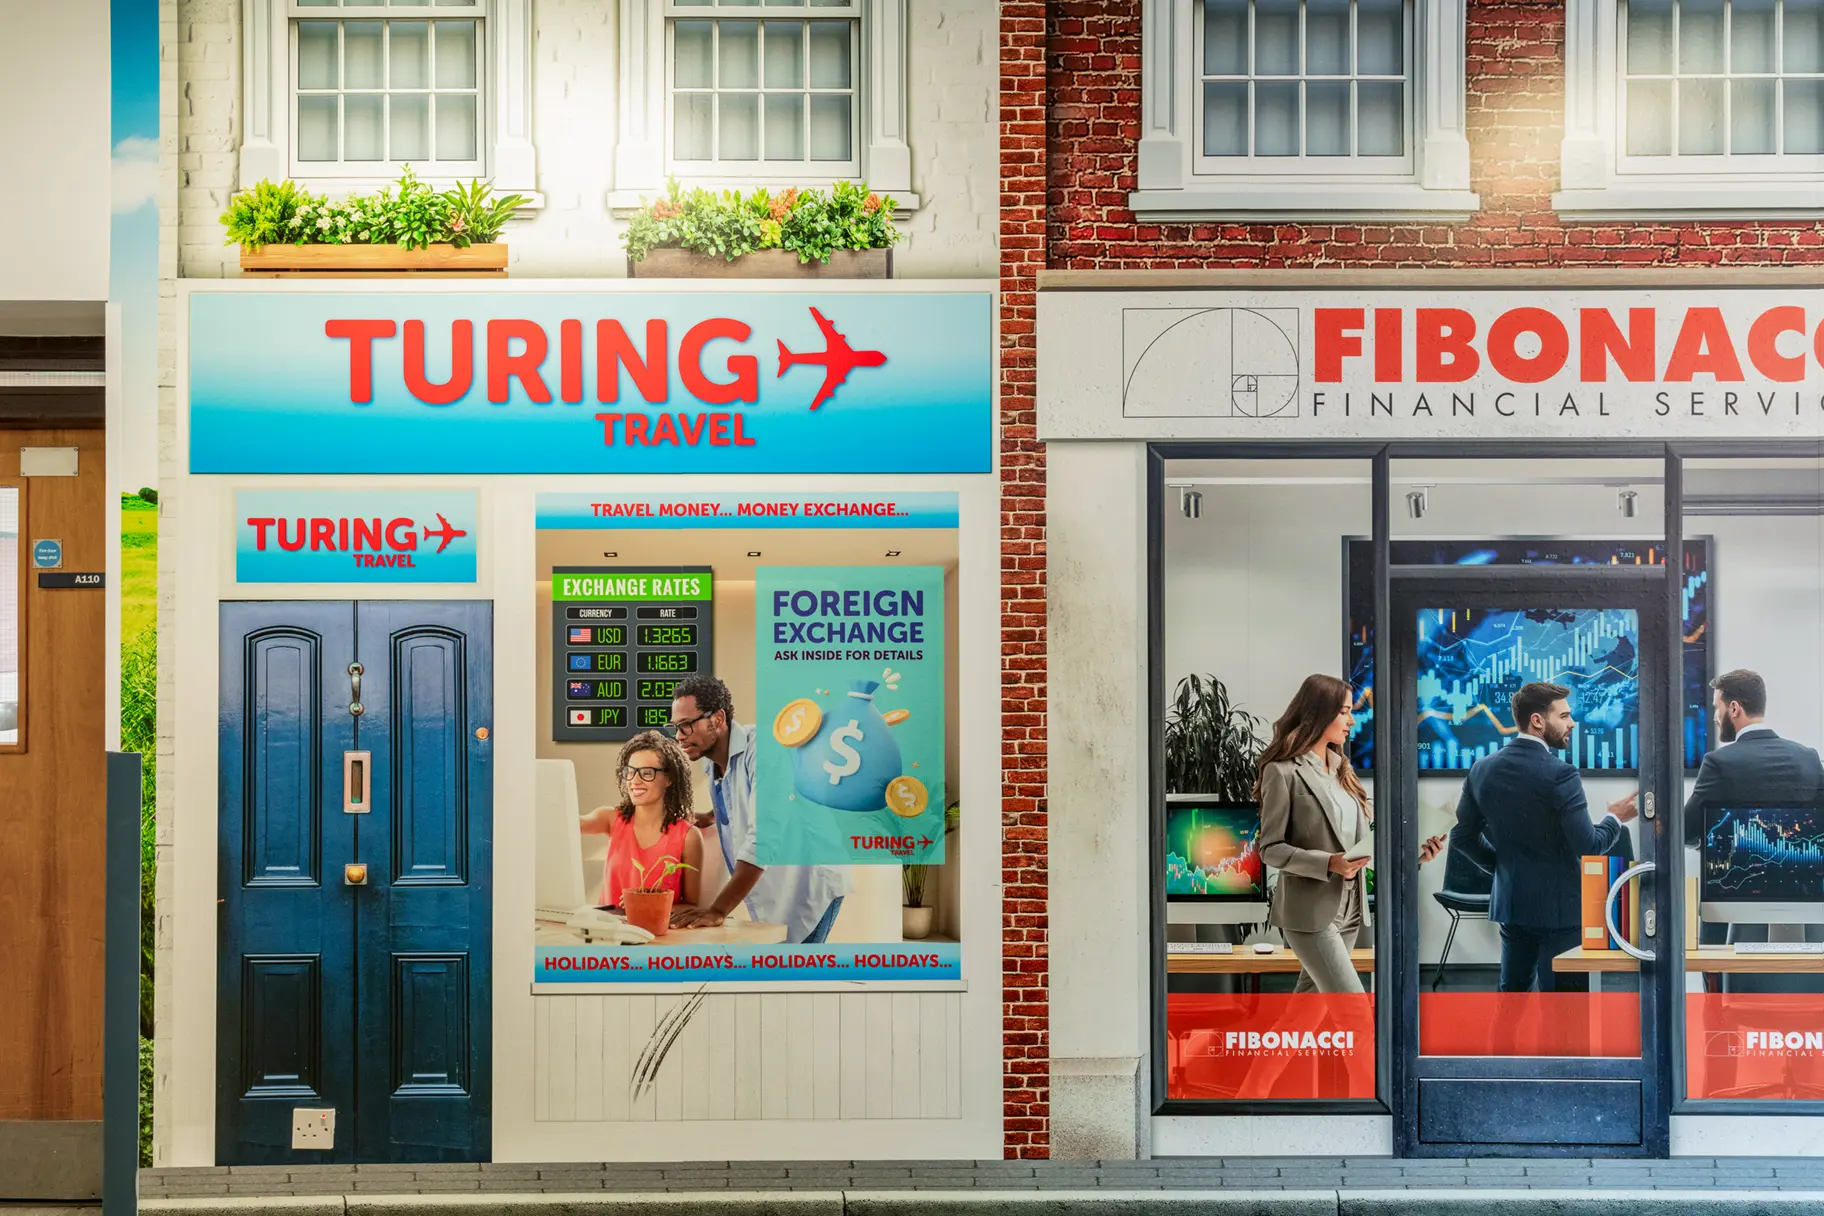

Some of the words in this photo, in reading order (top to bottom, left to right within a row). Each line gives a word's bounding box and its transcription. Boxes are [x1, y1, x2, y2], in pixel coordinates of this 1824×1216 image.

[1314, 305, 1824, 383] FIBONAC
[324, 317, 760, 405] TURING
[1313, 392, 1610, 417] FINANCIAL
[1655, 391, 1824, 416] SERVI
[595, 412, 757, 447] TRAVEL
[590, 503, 655, 517] TRAVEL
[658, 502, 732, 517] MONEY...
[737, 502, 799, 516] MONEY
[804, 502, 909, 516] EXCHANGE...
[246, 517, 418, 552] TURING
[352, 553, 416, 568] TRAVEL
[75, 575, 100, 583] A110
[563, 578, 647, 596] EXCHANGE
[652, 578, 701, 596] RATES
[773, 590, 924, 617] FOREIGN
[579, 609, 612, 618] CURRENCY
[659, 609, 676, 618] RATE
[597, 628, 621, 643] USD
[644, 628, 691, 643] 1.3265
[773, 622, 924, 643] EXCHANGE
[597, 654, 621, 670] EUR
[647, 655, 688, 670] 1.1663
[774, 650, 798, 661] ASK
[802, 650, 842, 661] INSIDE
[846, 650, 870, 661] FOR
[874, 650, 923, 661] DETAILS
[597, 682, 621, 697] AUD
[598, 709, 619, 725] JPY
[850, 835, 915, 849] TURING
[545, 957, 643, 971] HOLIDAYS...
[648, 955, 747, 970] HOLIDAYS...
[751, 954, 850, 969] HOLIDAYS...
[854, 954, 953, 968] HOLIDAYS...
[1225, 1031, 1354, 1049] FIBONACCI
